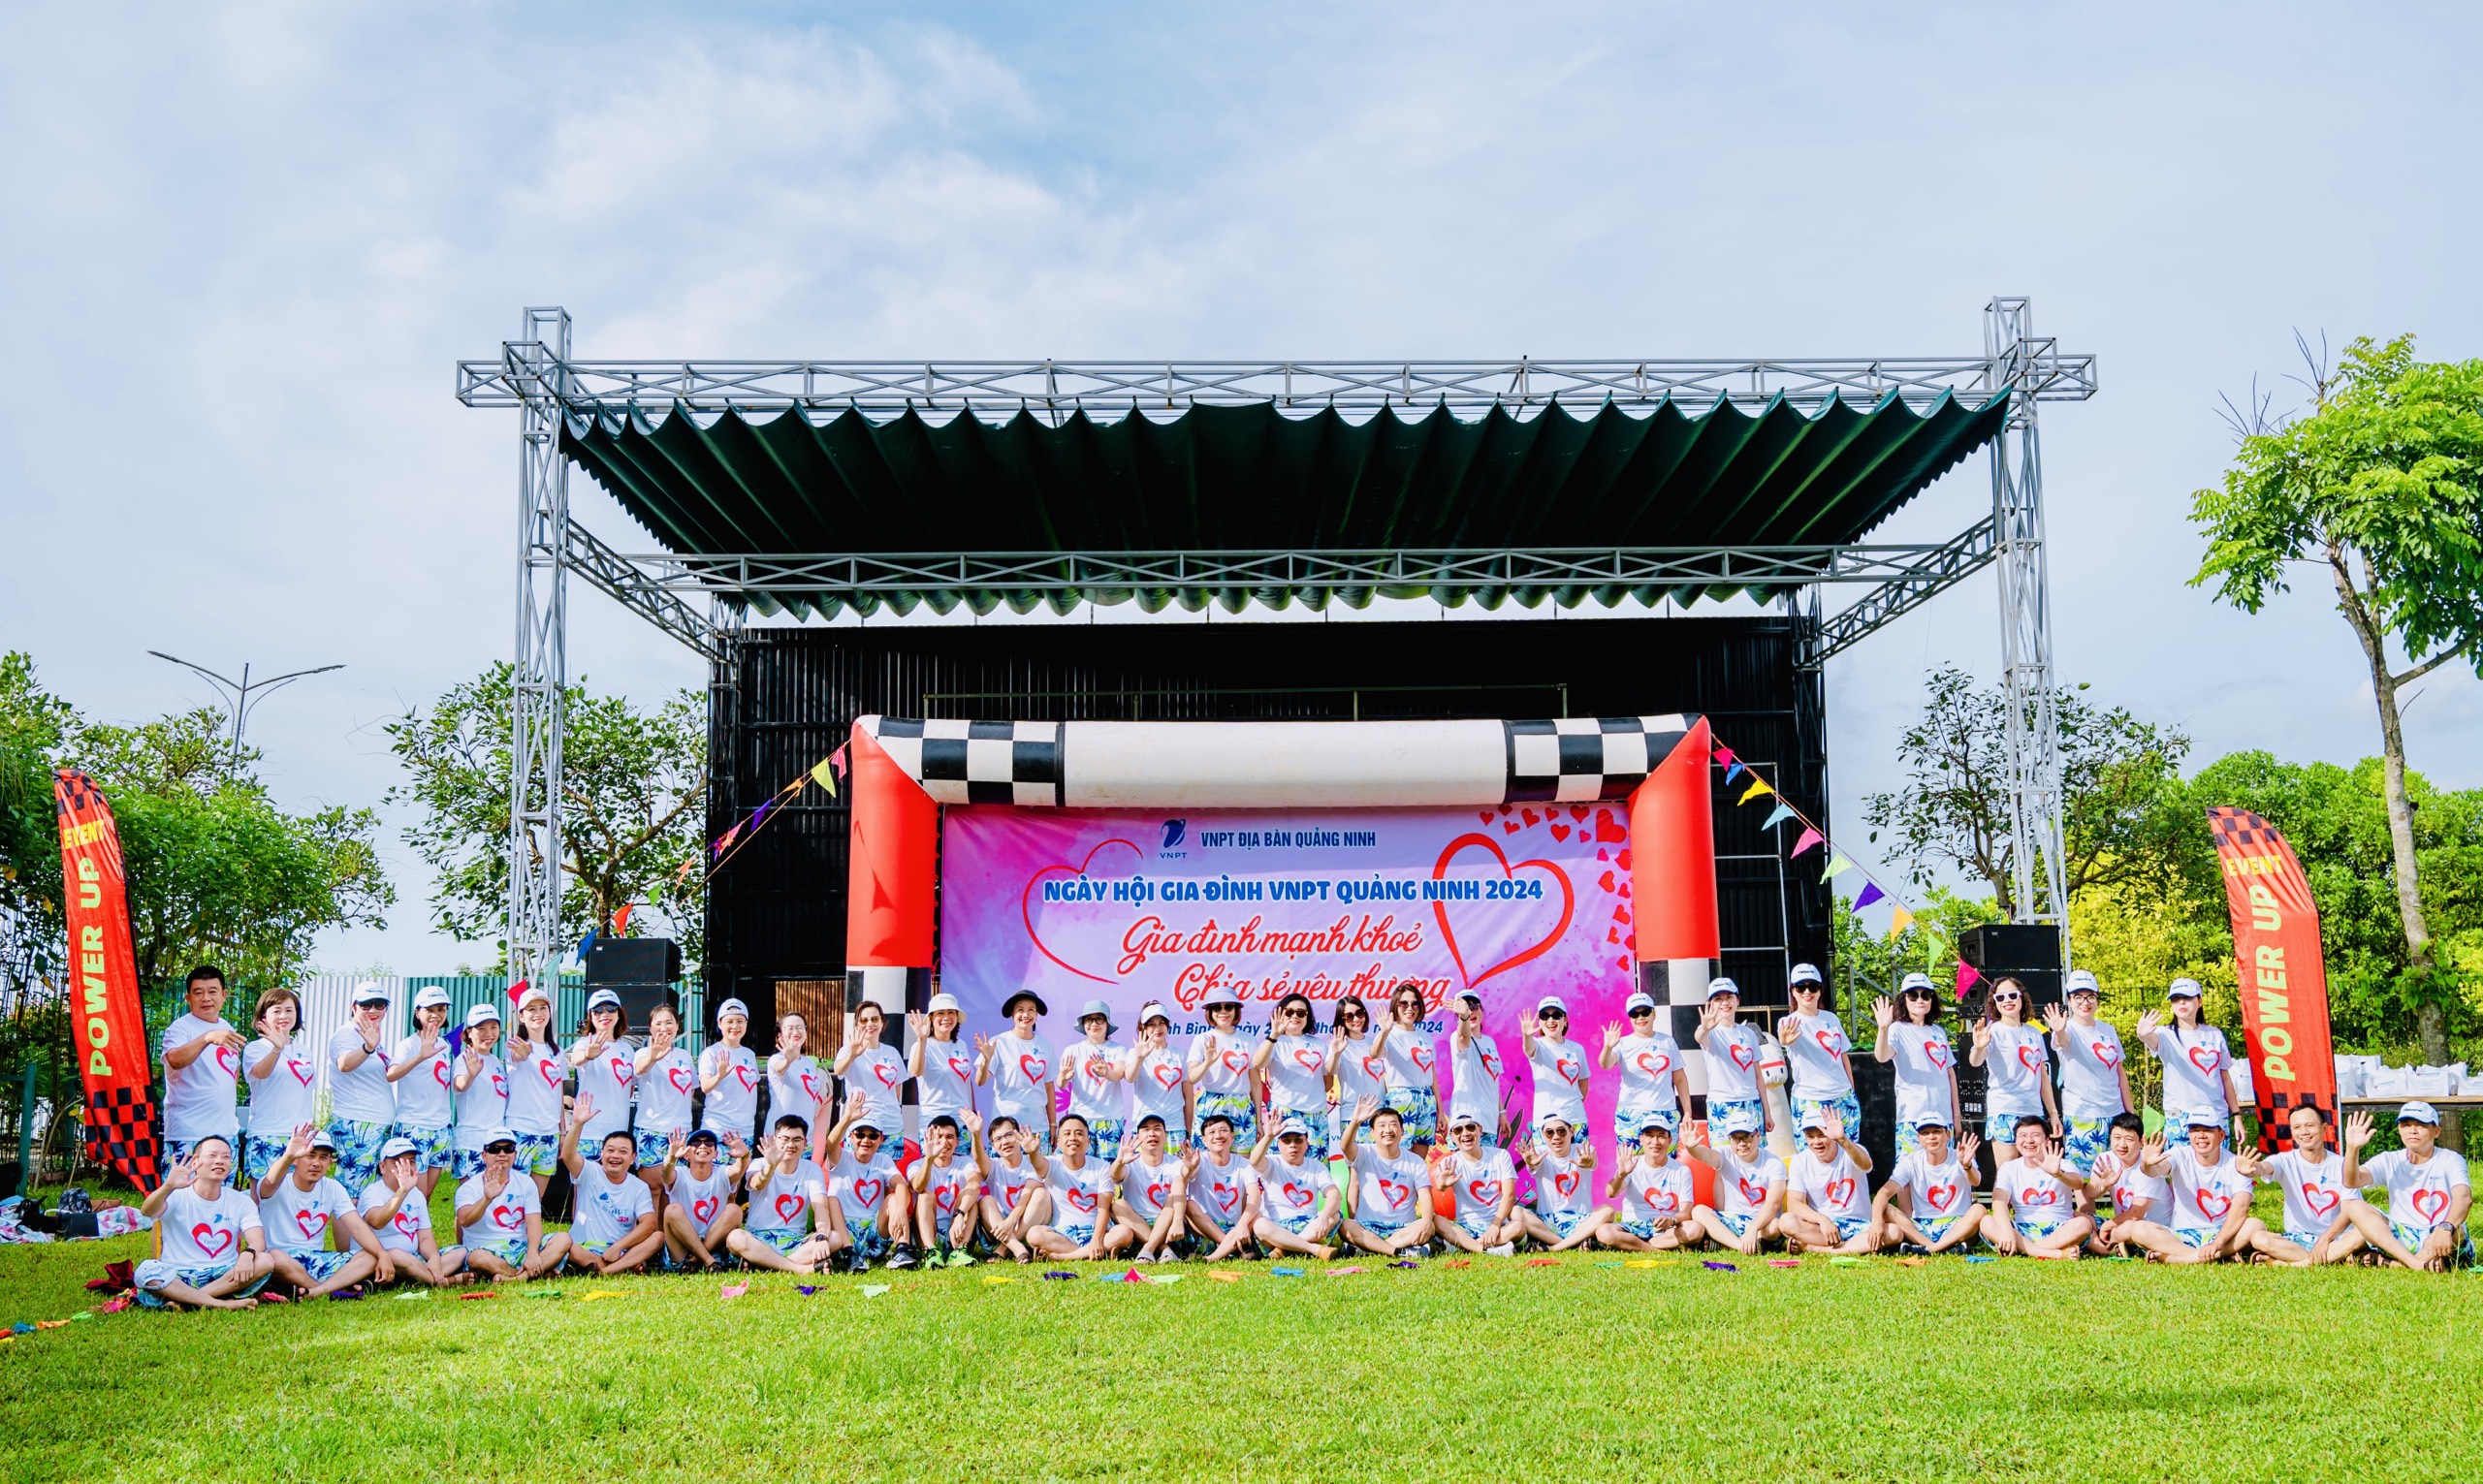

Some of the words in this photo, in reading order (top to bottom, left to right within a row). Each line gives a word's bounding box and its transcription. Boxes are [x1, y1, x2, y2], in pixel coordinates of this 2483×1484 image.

[64, 820, 105, 850] EVENT
[1201, 832, 1235, 847] VNPT
[1238, 832, 1260, 850] ĐỊA
[1264, 828, 1292, 847] BÀN
[1295, 827, 1340, 848] QUẢNG
[1344, 832, 1376, 846] NINH
[79, 857, 102, 909] UP
[1044, 874, 1107, 901] NGÀY
[1113, 876, 1154, 907] HỘI
[1160, 881, 1199, 901] GIA
[1202, 874, 1261, 901] ĐÌNH
[1269, 881, 1330, 901] VNPT
[1337, 873, 1417, 904] QUẢNG
[1423, 880, 1480, 900] NINH
[1485, 879, 1543, 900] 2024
[2226, 855, 2281, 877] EVENT
[2248, 884, 2281, 931] UP
[1116, 916, 1187, 974] Gia
[1187, 915, 1261, 953] đình
[1260, 915, 1351, 960] mạnh
[1350, 914, 1423, 953] khoẻ
[80, 925, 112, 1077] POWER
[1257, 971, 1291, 1001] sẻ
[1349, 963, 1451, 1014] thưng
[2255, 945, 2296, 1081] POWER
